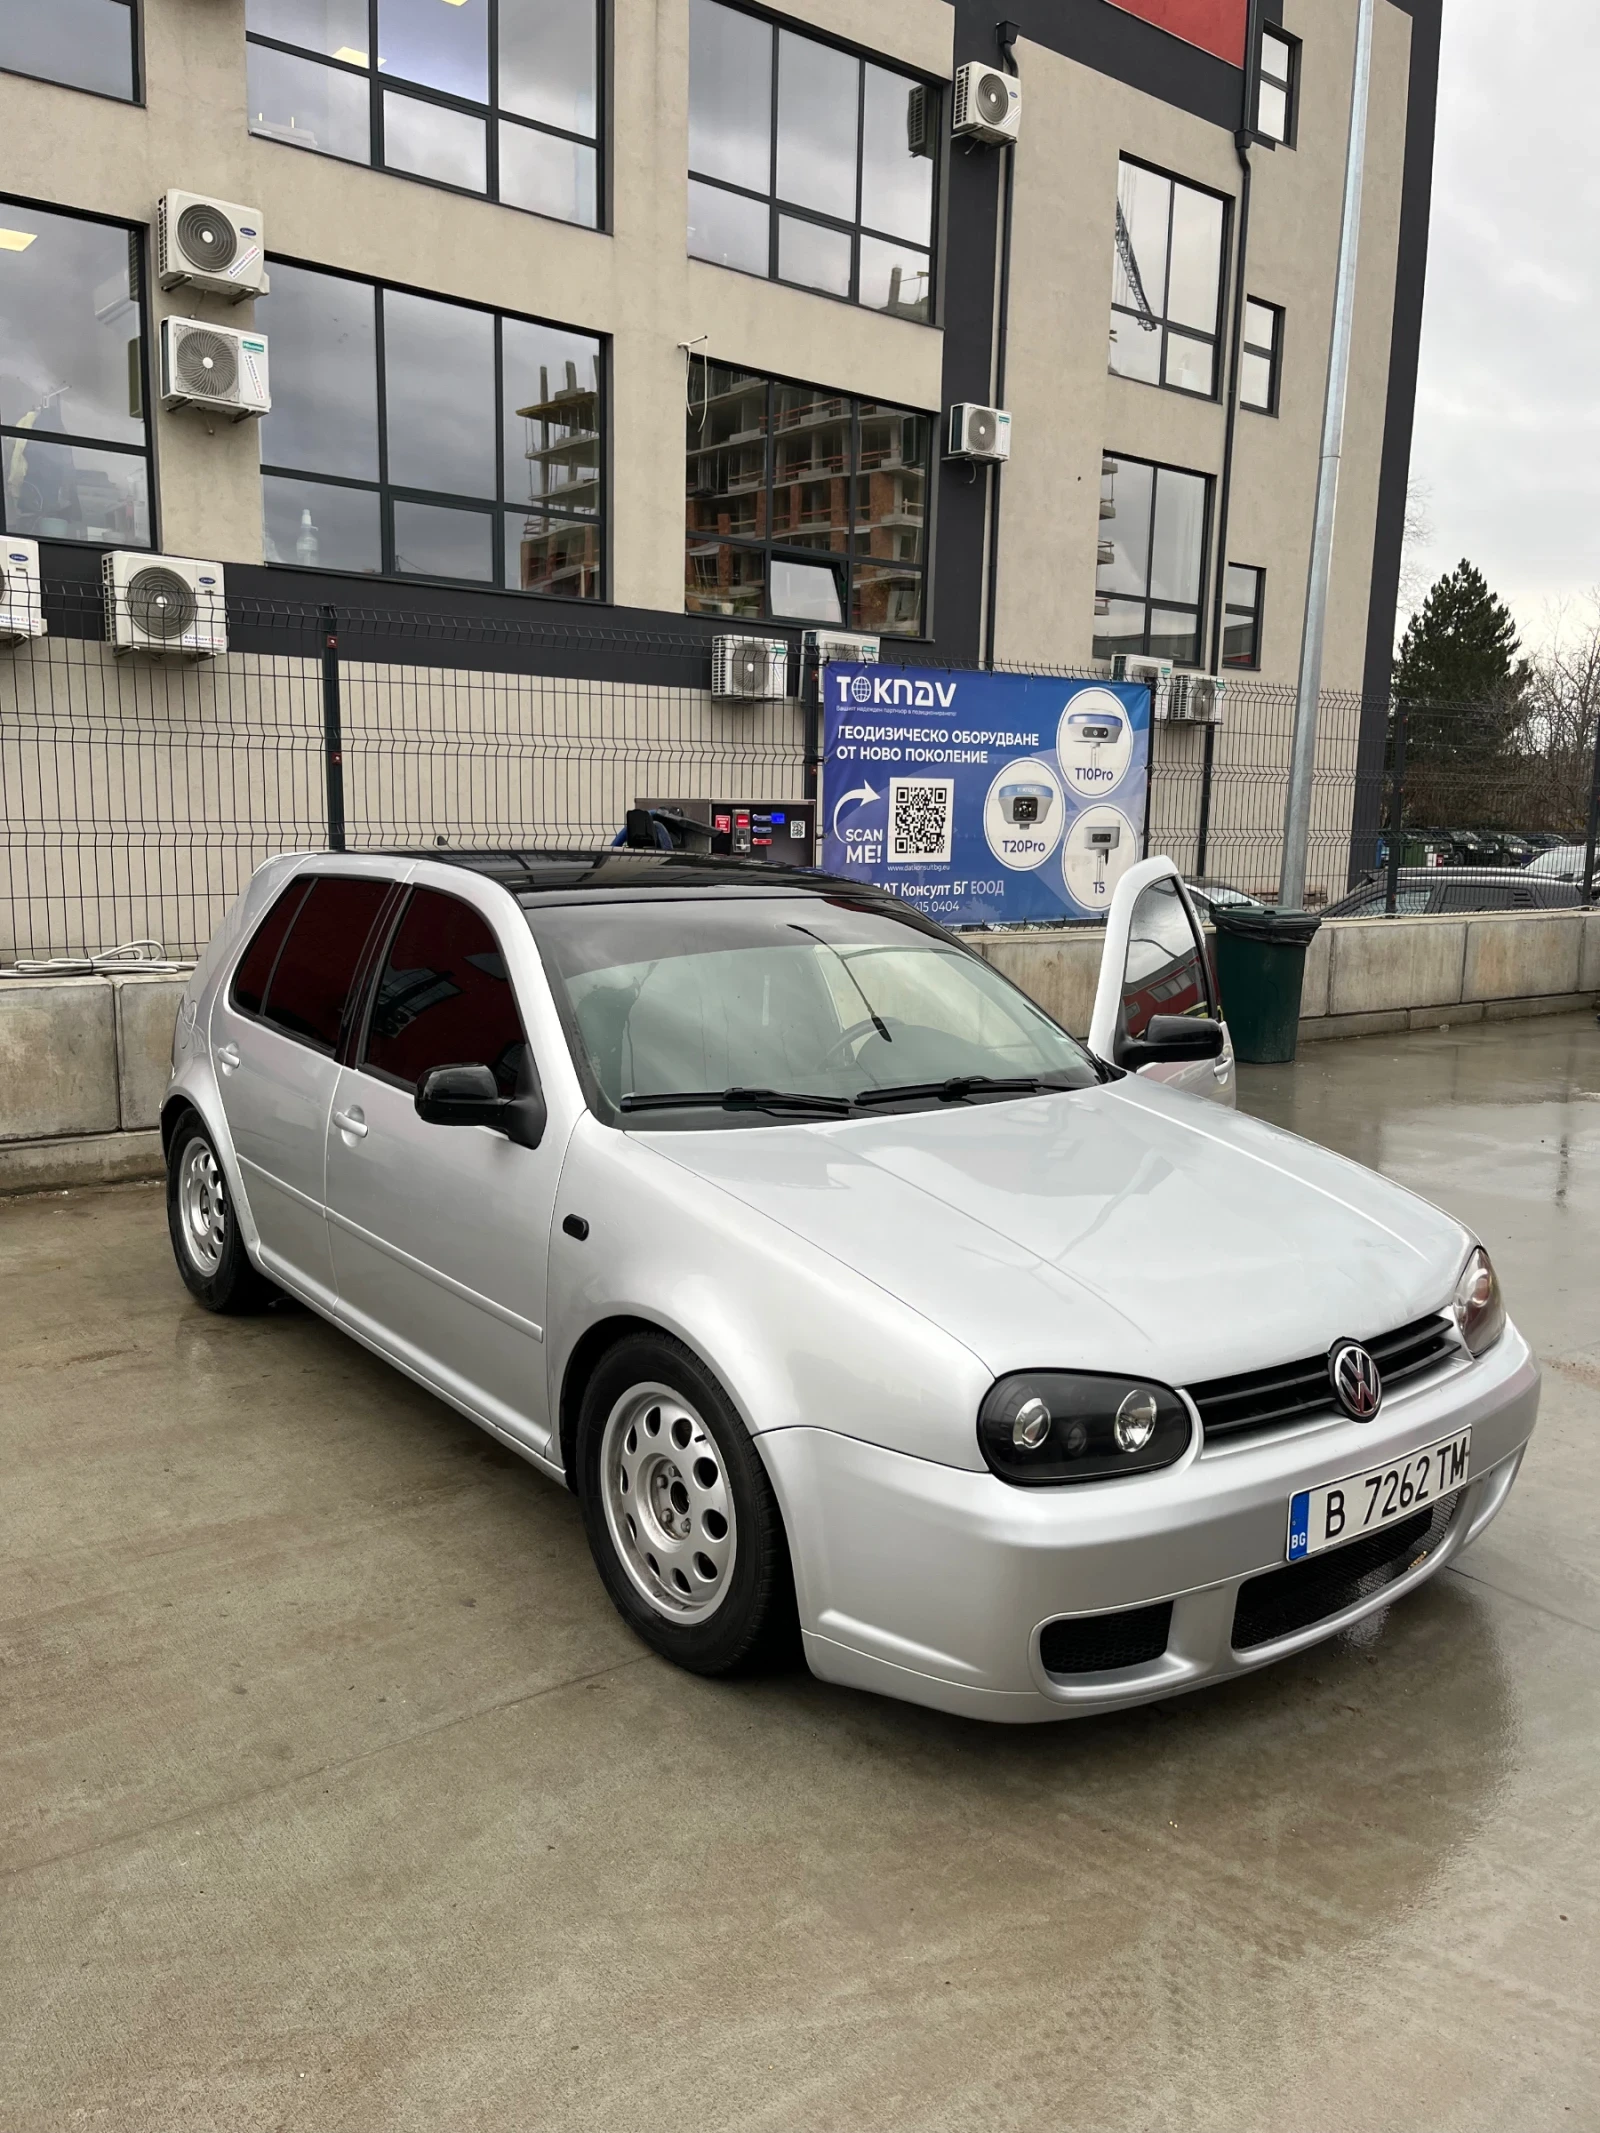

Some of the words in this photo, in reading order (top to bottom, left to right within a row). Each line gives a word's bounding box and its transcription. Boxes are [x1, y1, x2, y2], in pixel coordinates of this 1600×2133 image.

[838, 725, 949, 743] ГЕОДИЗИЧЕСКО
[951, 730, 1040, 747] ОБОРУДВАНЕ
[836, 746, 857, 760] ОТ
[860, 746, 902, 762] НОВО
[905, 747, 989, 764] ПОКОЛЕНИЕ
[1075, 767, 1114, 781] T10Pro
[845, 829, 884, 842] SCAN
[846, 845, 882, 864] ME!
[1003, 840, 1046, 853] T20Pro
[873, 882, 899, 896] АТ
[901, 882, 951, 899] Консулт
[953, 881, 969, 896] БГ
[971, 880, 1005, 896] ЕООД
[1093, 882, 1105, 894] T5
[931, 901, 960, 913] 0404
[1325, 1489, 1346, 1539] B
[1363, 1455, 1430, 1526] 7262
[1437, 1436, 1467, 1491] TM
[1291, 1532, 1306, 1549] BG
